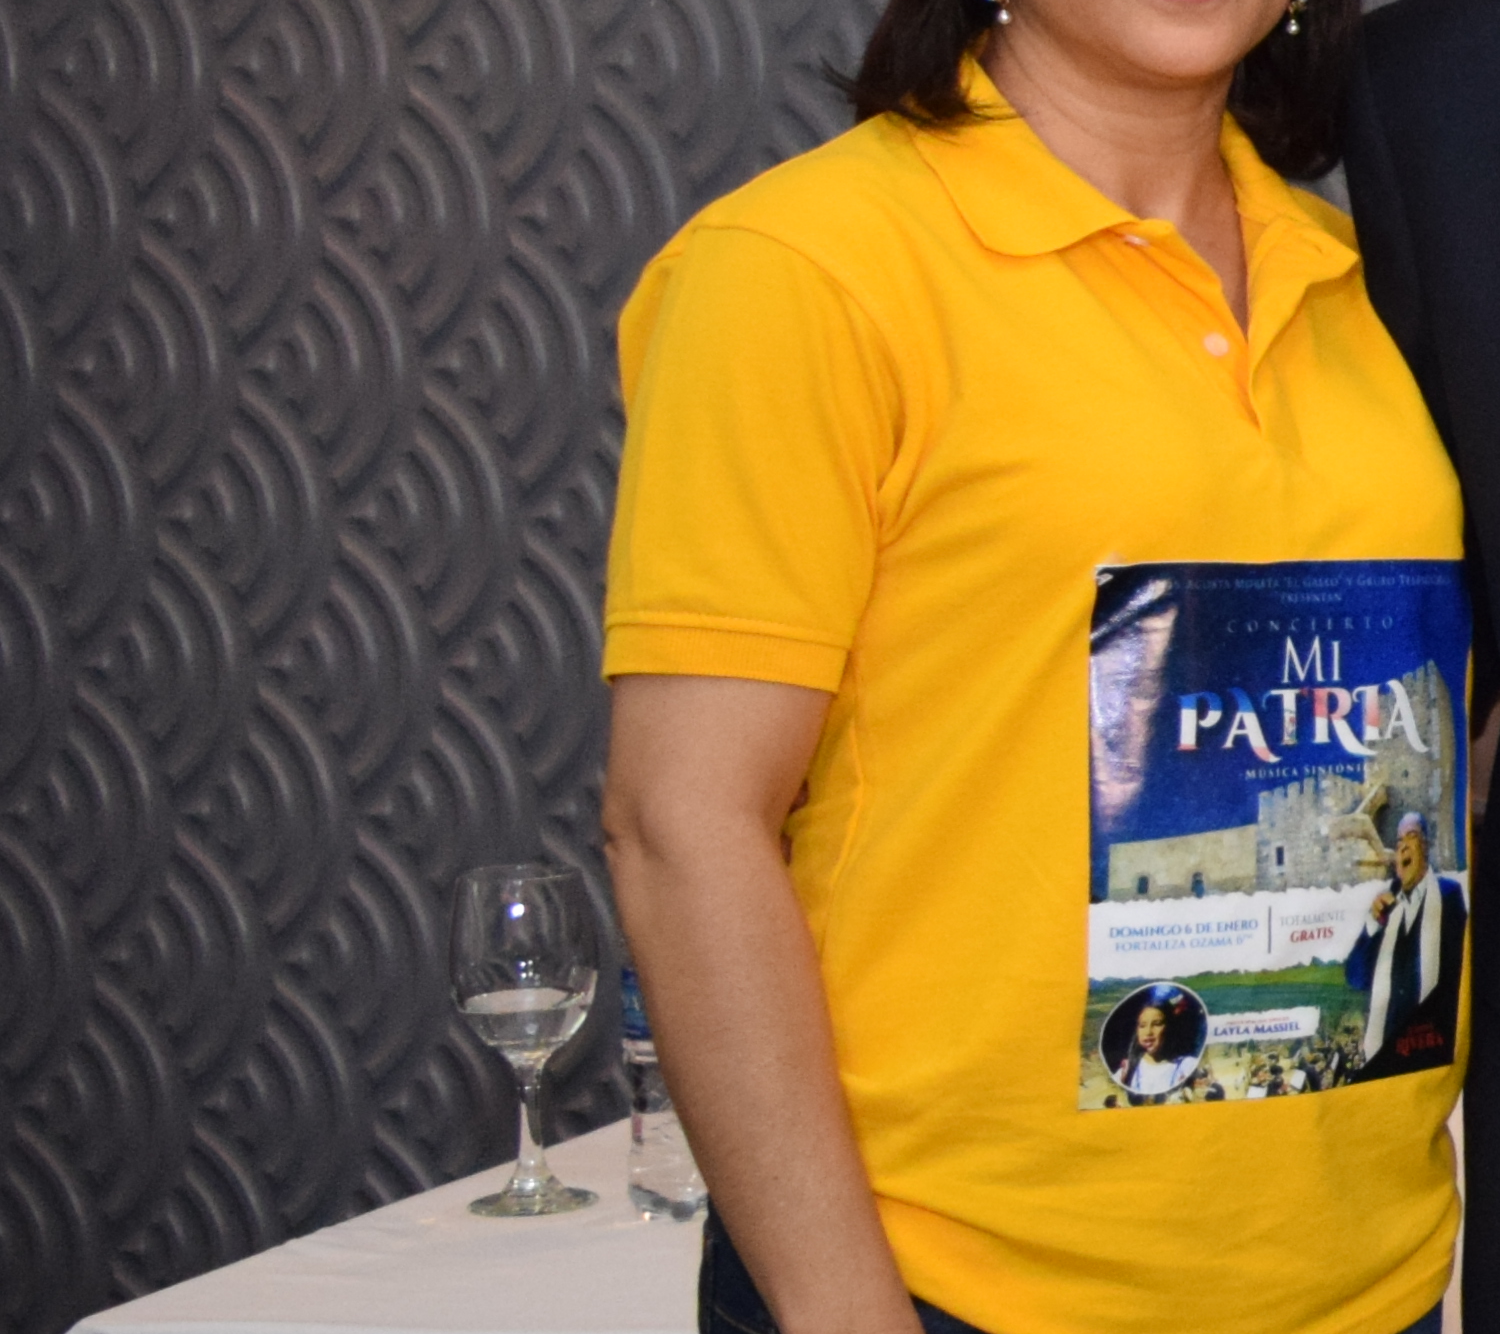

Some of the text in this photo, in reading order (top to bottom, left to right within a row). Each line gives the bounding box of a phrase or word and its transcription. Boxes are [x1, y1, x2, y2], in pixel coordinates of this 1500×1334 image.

[1281, 635, 1342, 684] MI
[1177, 679, 1430, 763] PATRIA
[1109, 924, 1182, 939] DOMINGO
[1195, 921, 1212, 935] DE
[1216, 918, 1259, 933] ENERO
[1289, 926, 1334, 944] GRATIS
[1114, 939, 1186, 953] FORTALEZA
[1189, 936, 1233, 950] OZAMA
